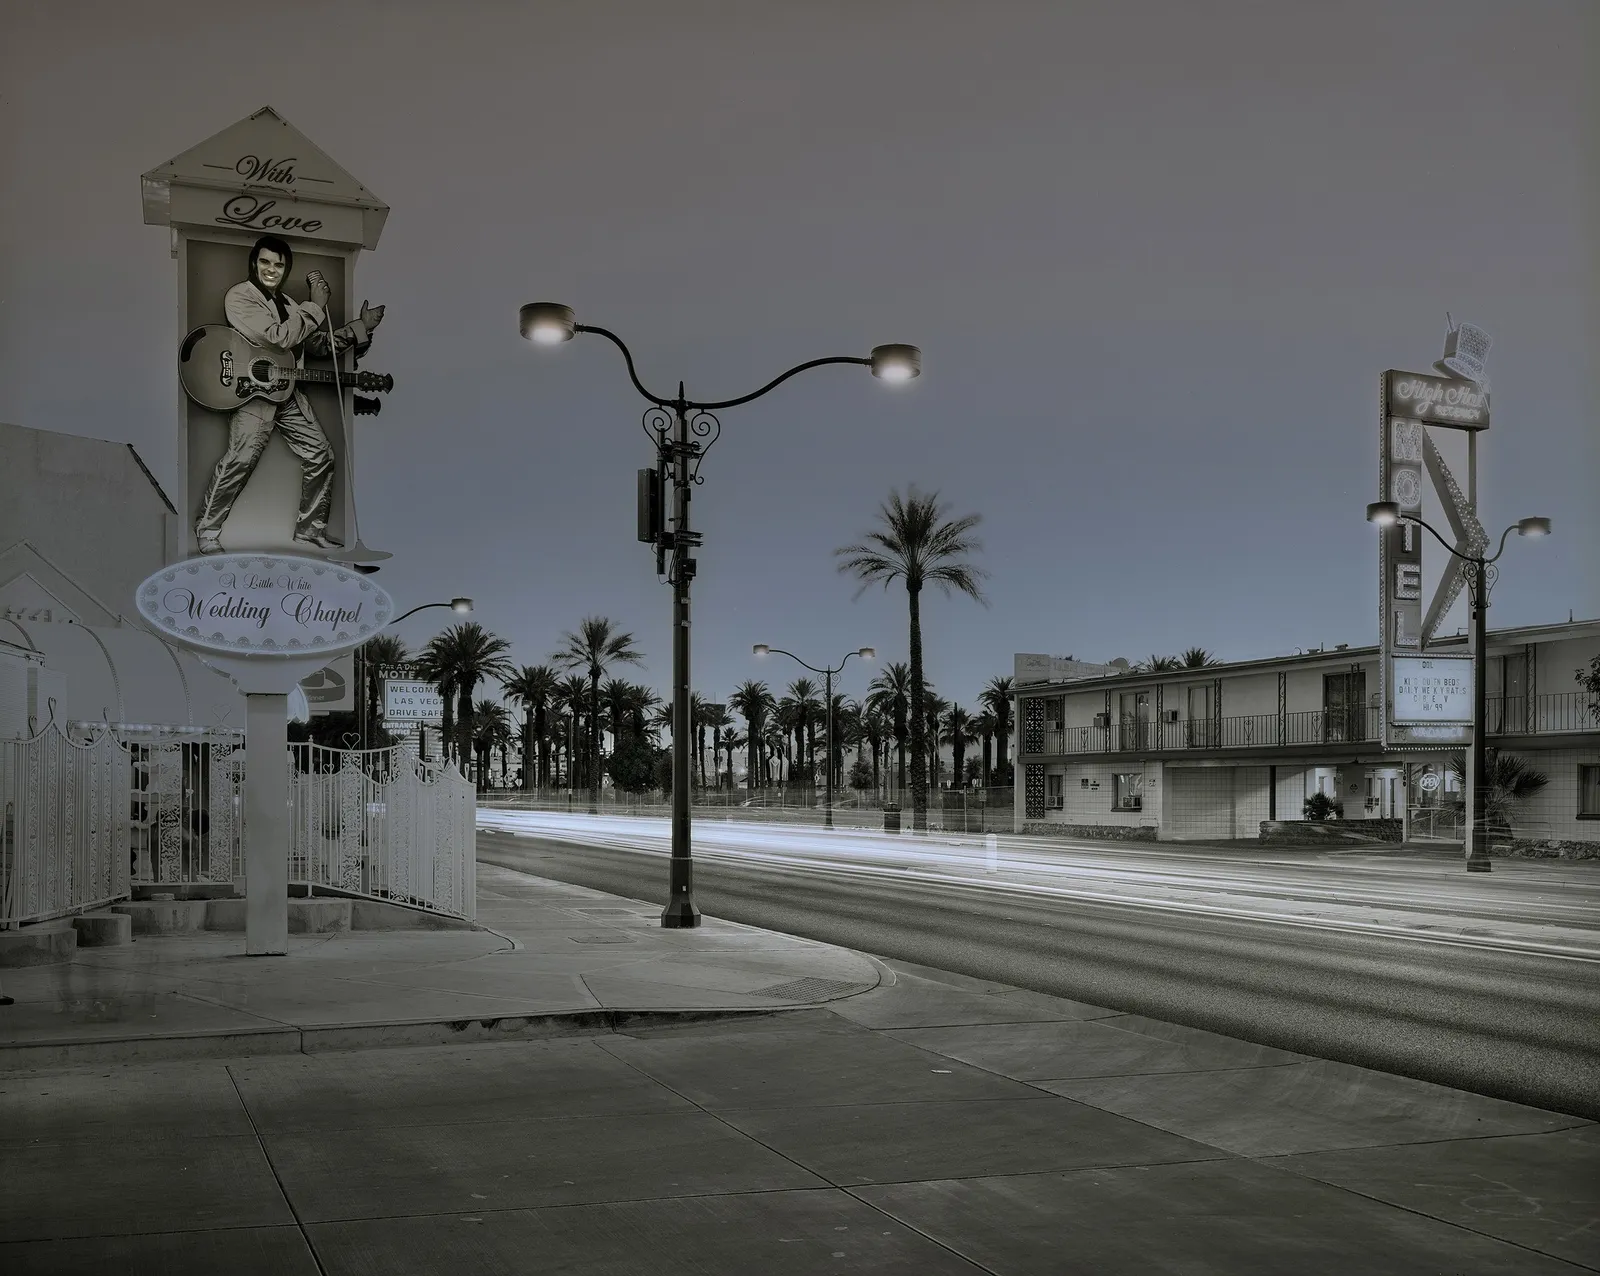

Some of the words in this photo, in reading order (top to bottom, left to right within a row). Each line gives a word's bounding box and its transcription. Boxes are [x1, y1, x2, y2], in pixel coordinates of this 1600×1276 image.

[235, 155, 297, 185] With
[215, 195, 323, 233] Love
[1393, 421, 1422, 647] MOTEL
[219, 572, 237, 589] A
[243, 573, 274, 590] Little
[277, 574, 312, 591] White
[163, 587, 272, 629] Wedding
[280, 592, 363, 631] Chapel
[378, 669, 423, 680] MOTE
[394, 697, 414, 705] LAS
